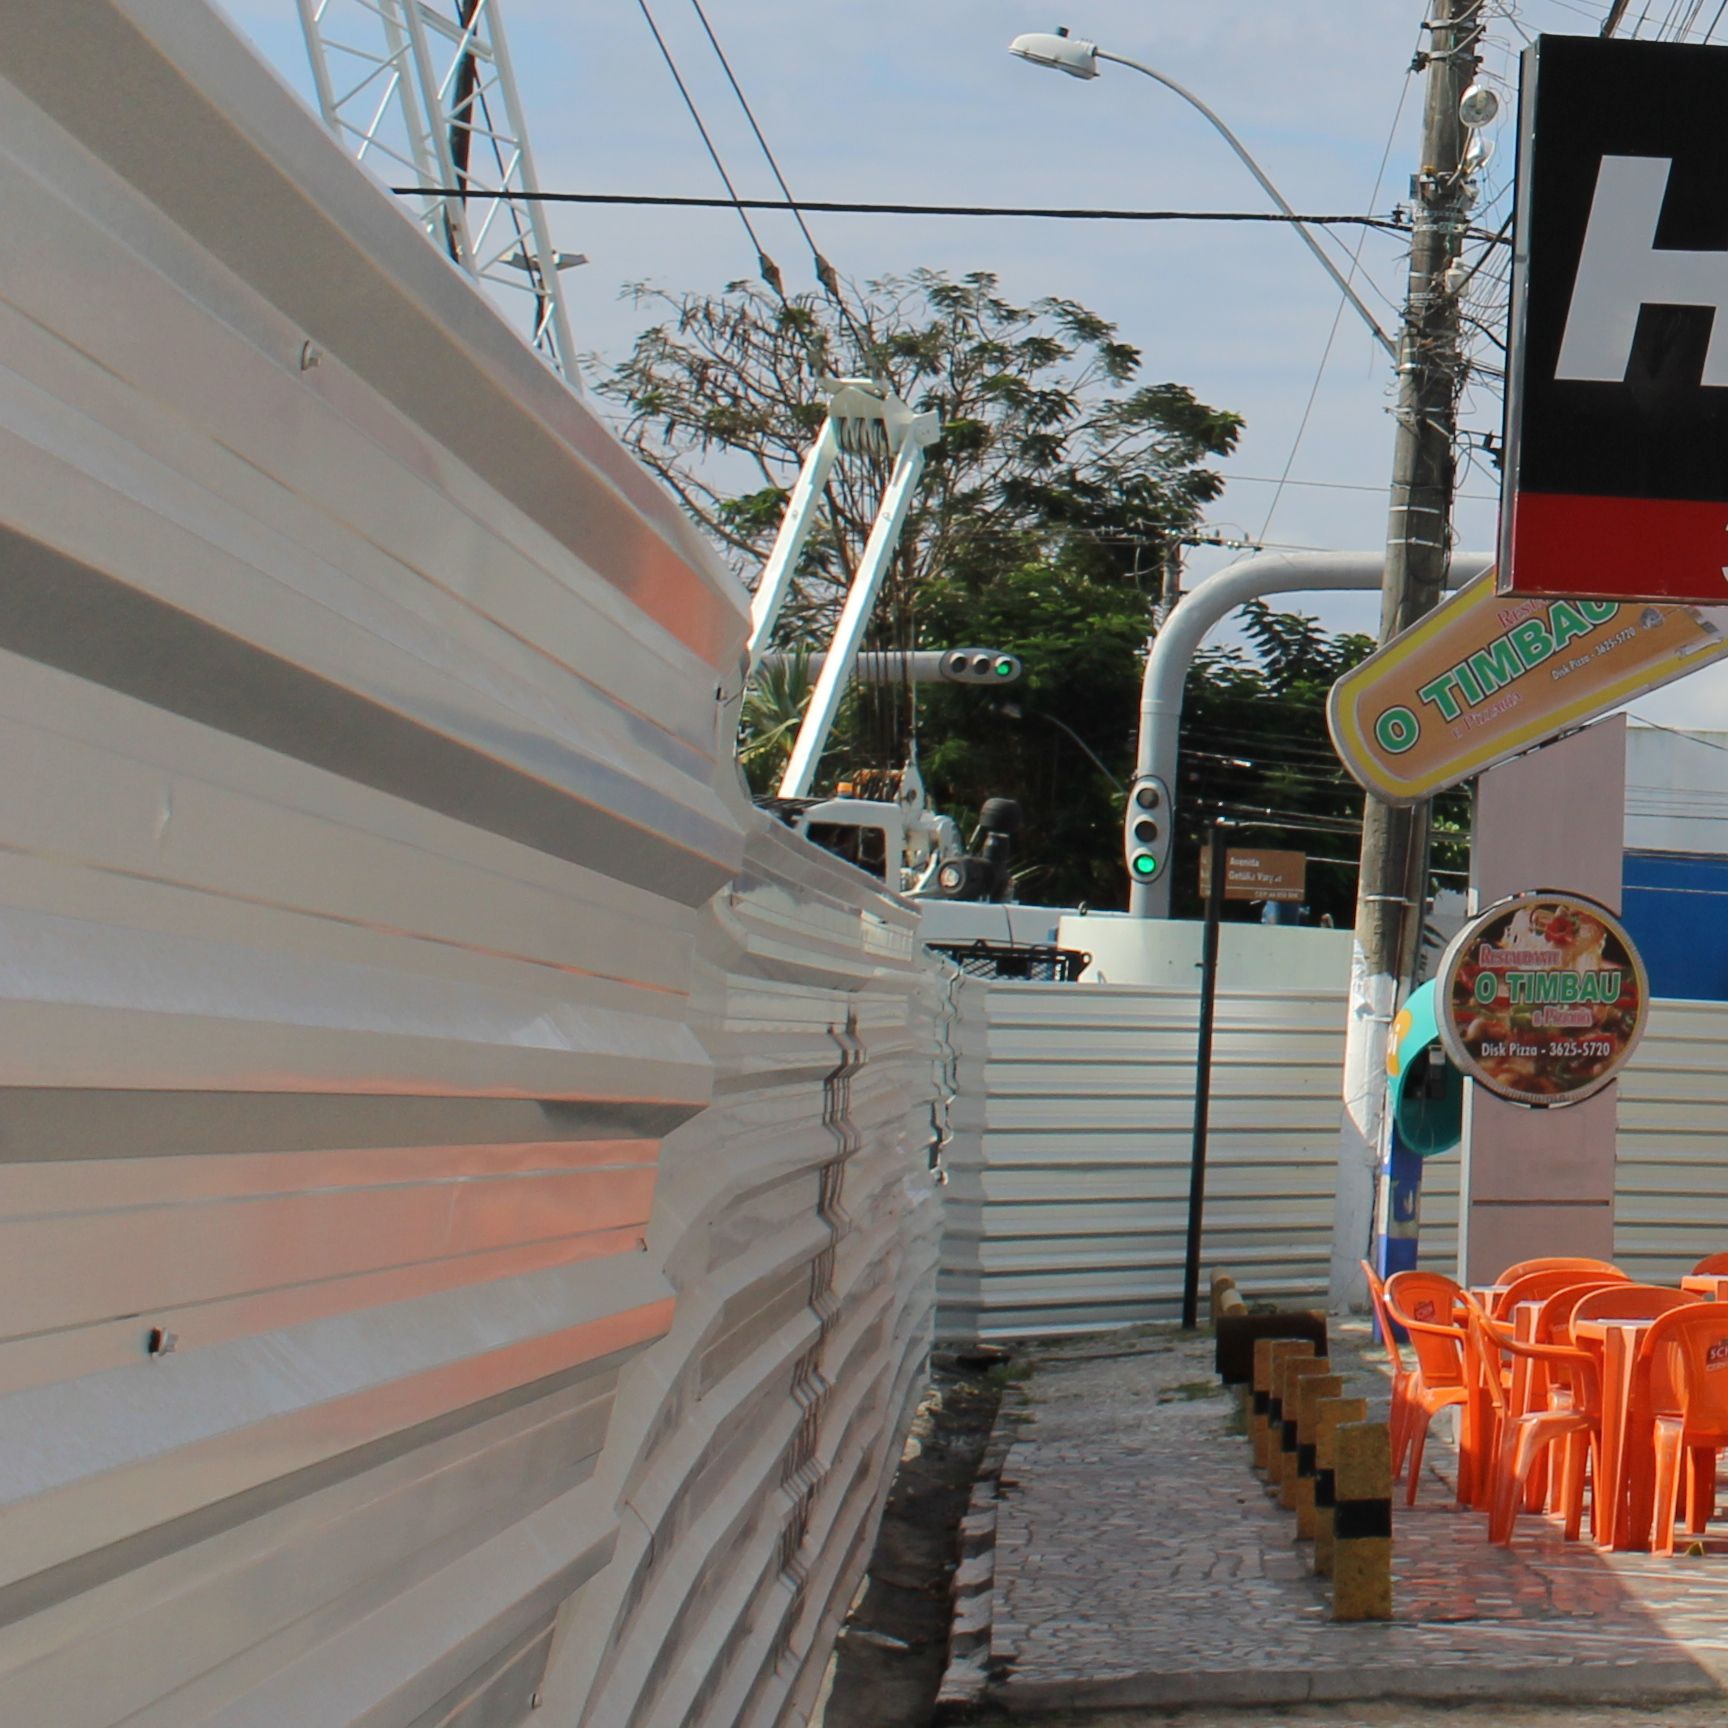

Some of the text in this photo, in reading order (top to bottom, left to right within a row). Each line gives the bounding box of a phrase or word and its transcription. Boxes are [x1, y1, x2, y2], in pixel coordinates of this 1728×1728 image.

[1375, 706, 1422, 756] O
[1475, 972, 1621, 1004] O TIMBAU
[1481, 1042, 1506, 1057] Disk
[1509, 1042, 1538, 1057] Pizza
[1549, 1041, 1611, 1057] 3625-5720
